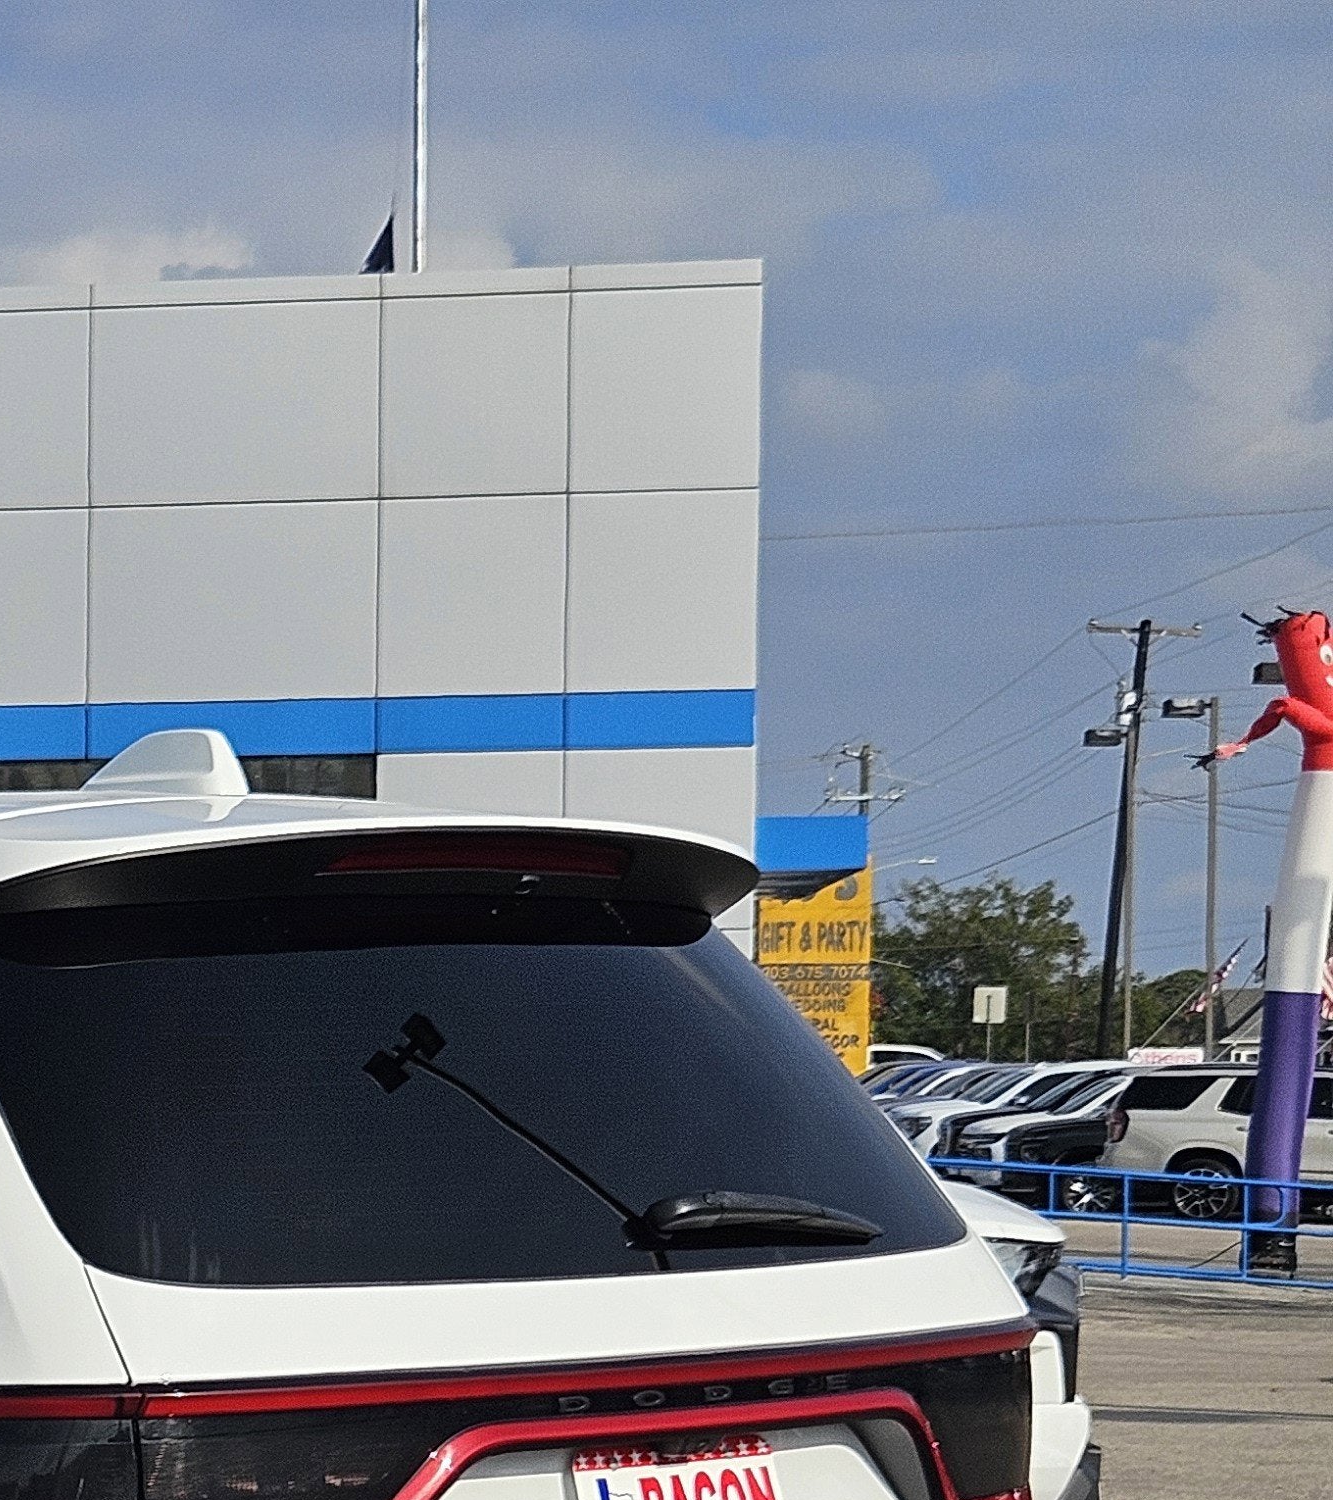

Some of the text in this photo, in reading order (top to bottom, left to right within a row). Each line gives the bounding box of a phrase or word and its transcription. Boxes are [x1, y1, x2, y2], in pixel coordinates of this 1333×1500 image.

[761, 919, 868, 953] GIFT & PARTY
[795, 965, 824, 979] 675
[831, 964, 868, 979] 7074
[792, 998, 847, 1013] EDDING
[558, 1373, 851, 1413] DODGE
